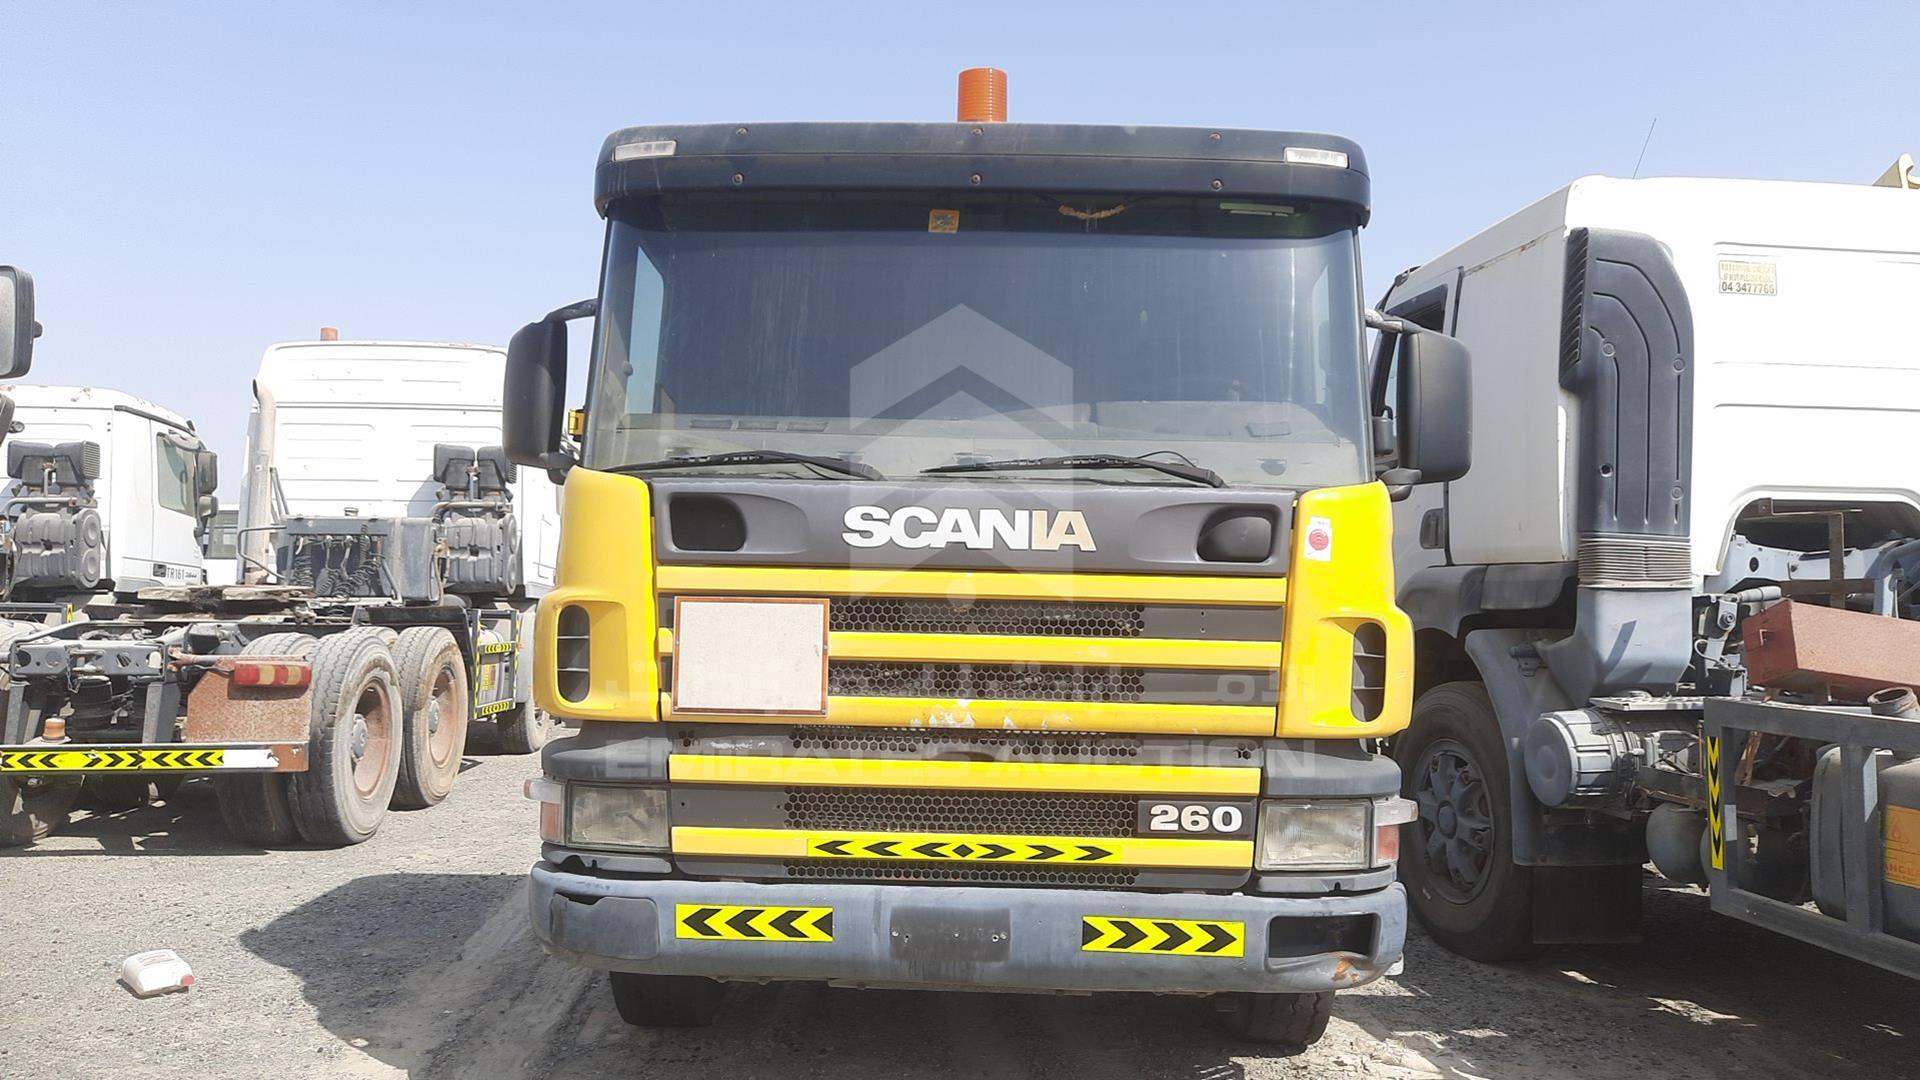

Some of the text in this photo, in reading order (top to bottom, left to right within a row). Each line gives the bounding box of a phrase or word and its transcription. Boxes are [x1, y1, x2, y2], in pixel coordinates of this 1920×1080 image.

[1721, 281, 1733, 292] 04
[841, 505, 1097, 551] SCANIA
[1150, 804, 1242, 832] 260
